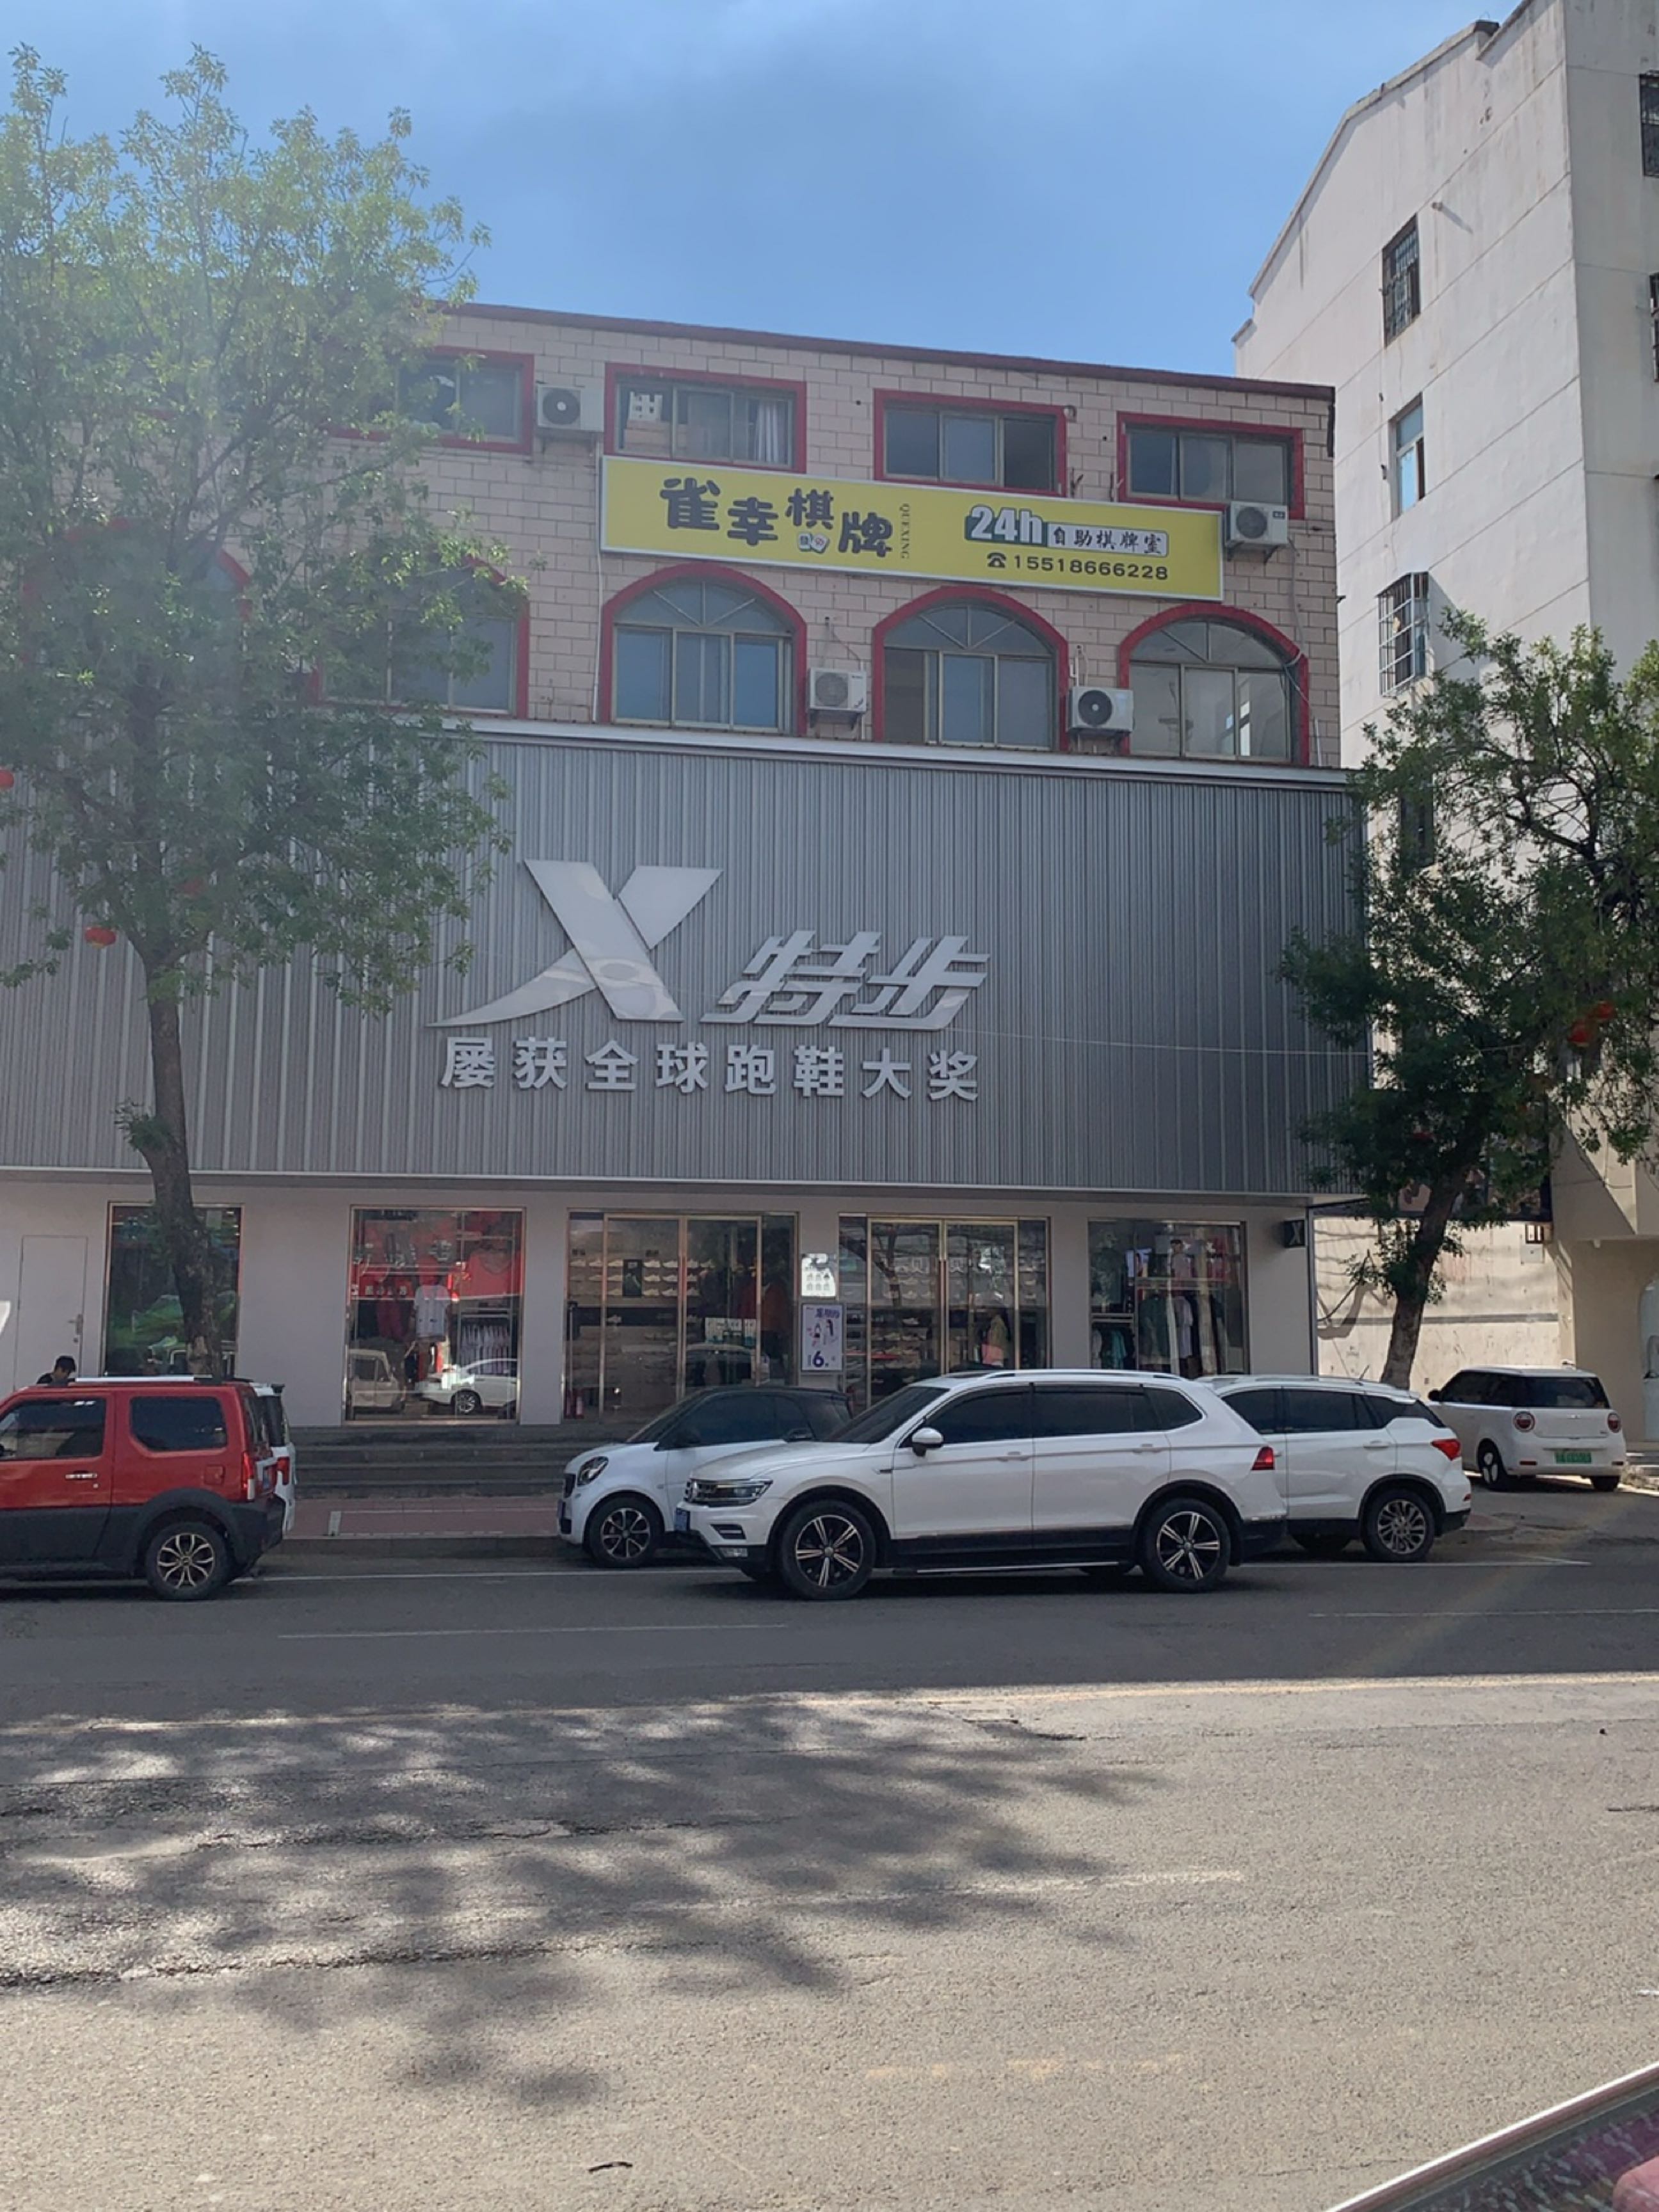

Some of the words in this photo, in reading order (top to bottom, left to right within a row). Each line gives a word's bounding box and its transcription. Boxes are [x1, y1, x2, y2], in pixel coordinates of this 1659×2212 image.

[659, 477, 893, 558] 雀幸棋牌
[970, 506, 1043, 545] 24h
[1053, 525, 1162, 555] 自助棋牌室
[1014, 554, 1169, 581] 15518666228
[698, 929, 991, 1032] 特步
[440, 1036, 979, 1103] 屡获全球跑鞋大奖
